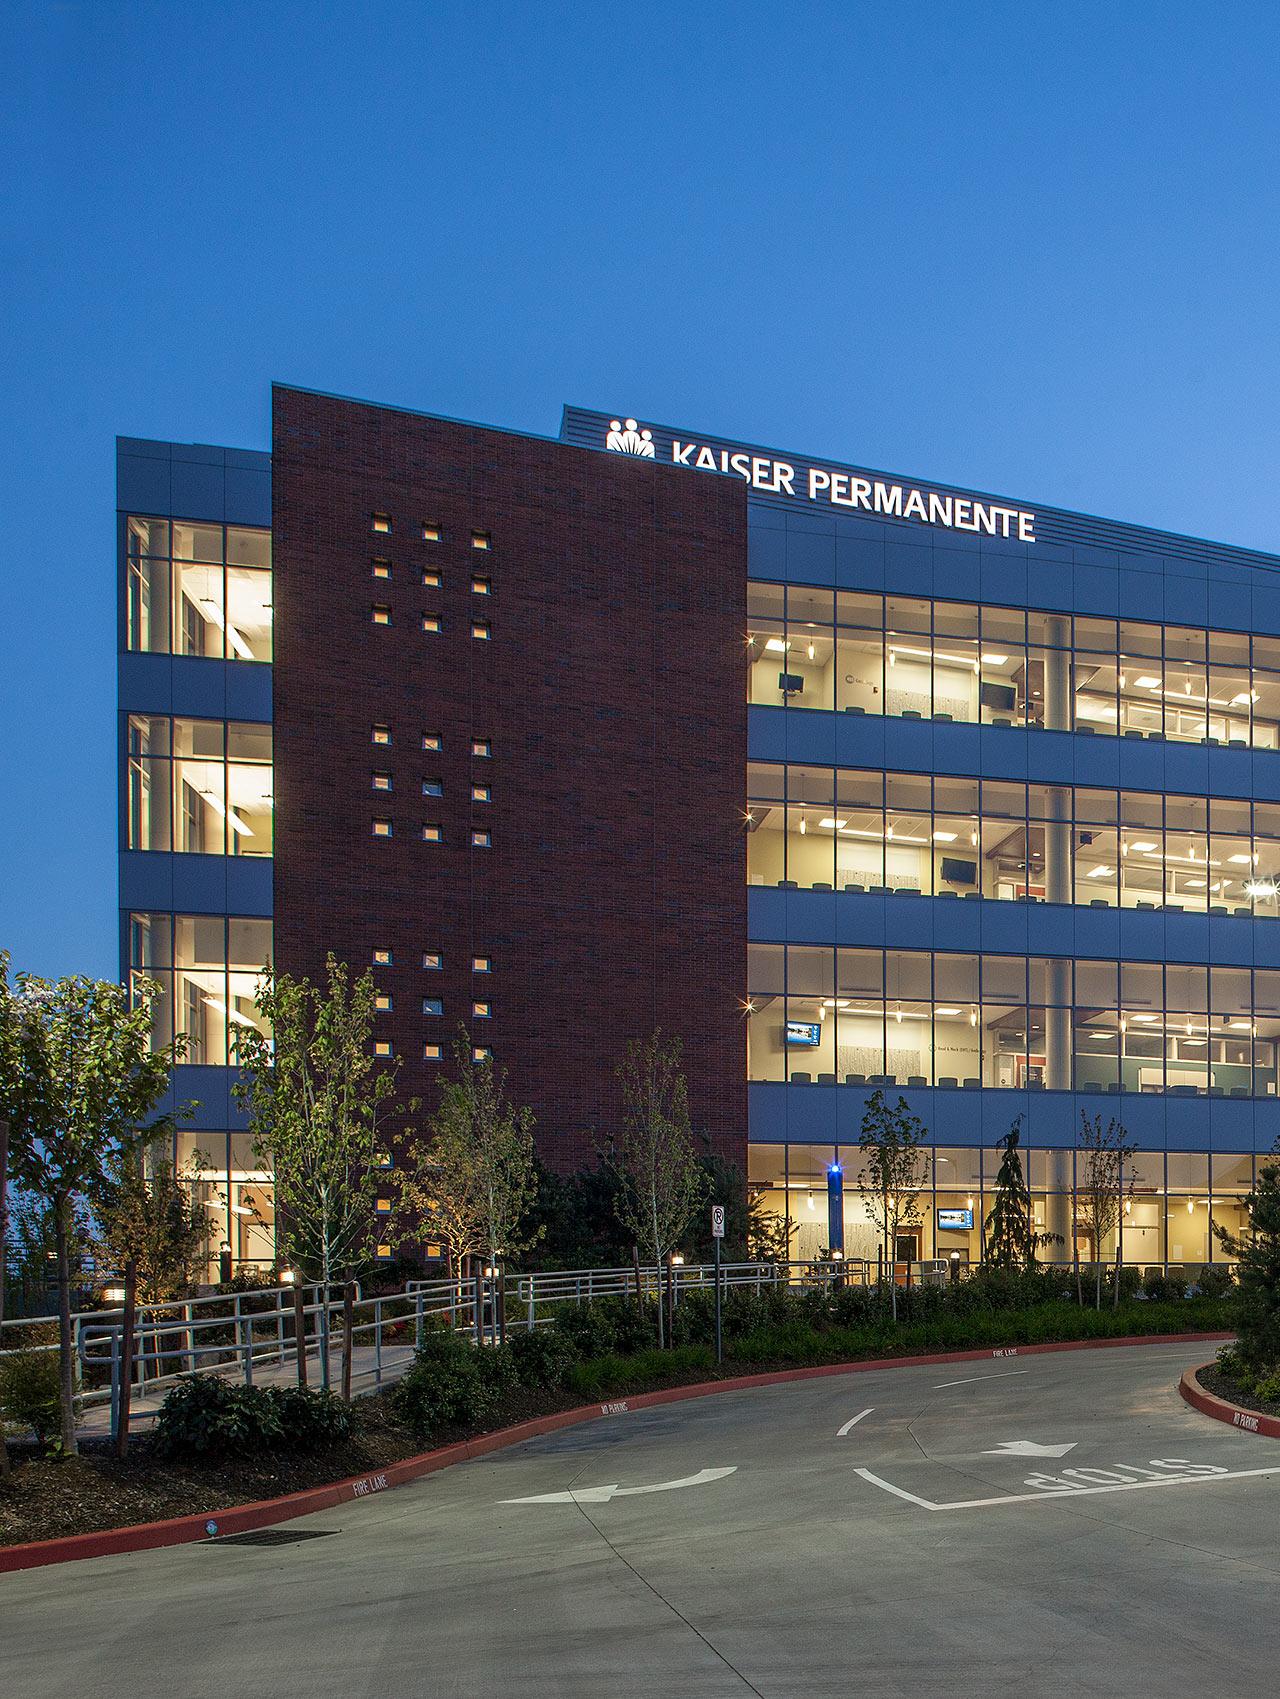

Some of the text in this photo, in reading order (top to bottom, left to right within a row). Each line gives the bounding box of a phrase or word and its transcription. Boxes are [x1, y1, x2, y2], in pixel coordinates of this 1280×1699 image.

[672, 440, 1036, 543] KAISER PERMANENTE
[352, 1474, 388, 1497] FIRE LANE
[1023, 1458, 1229, 1491] STOP
